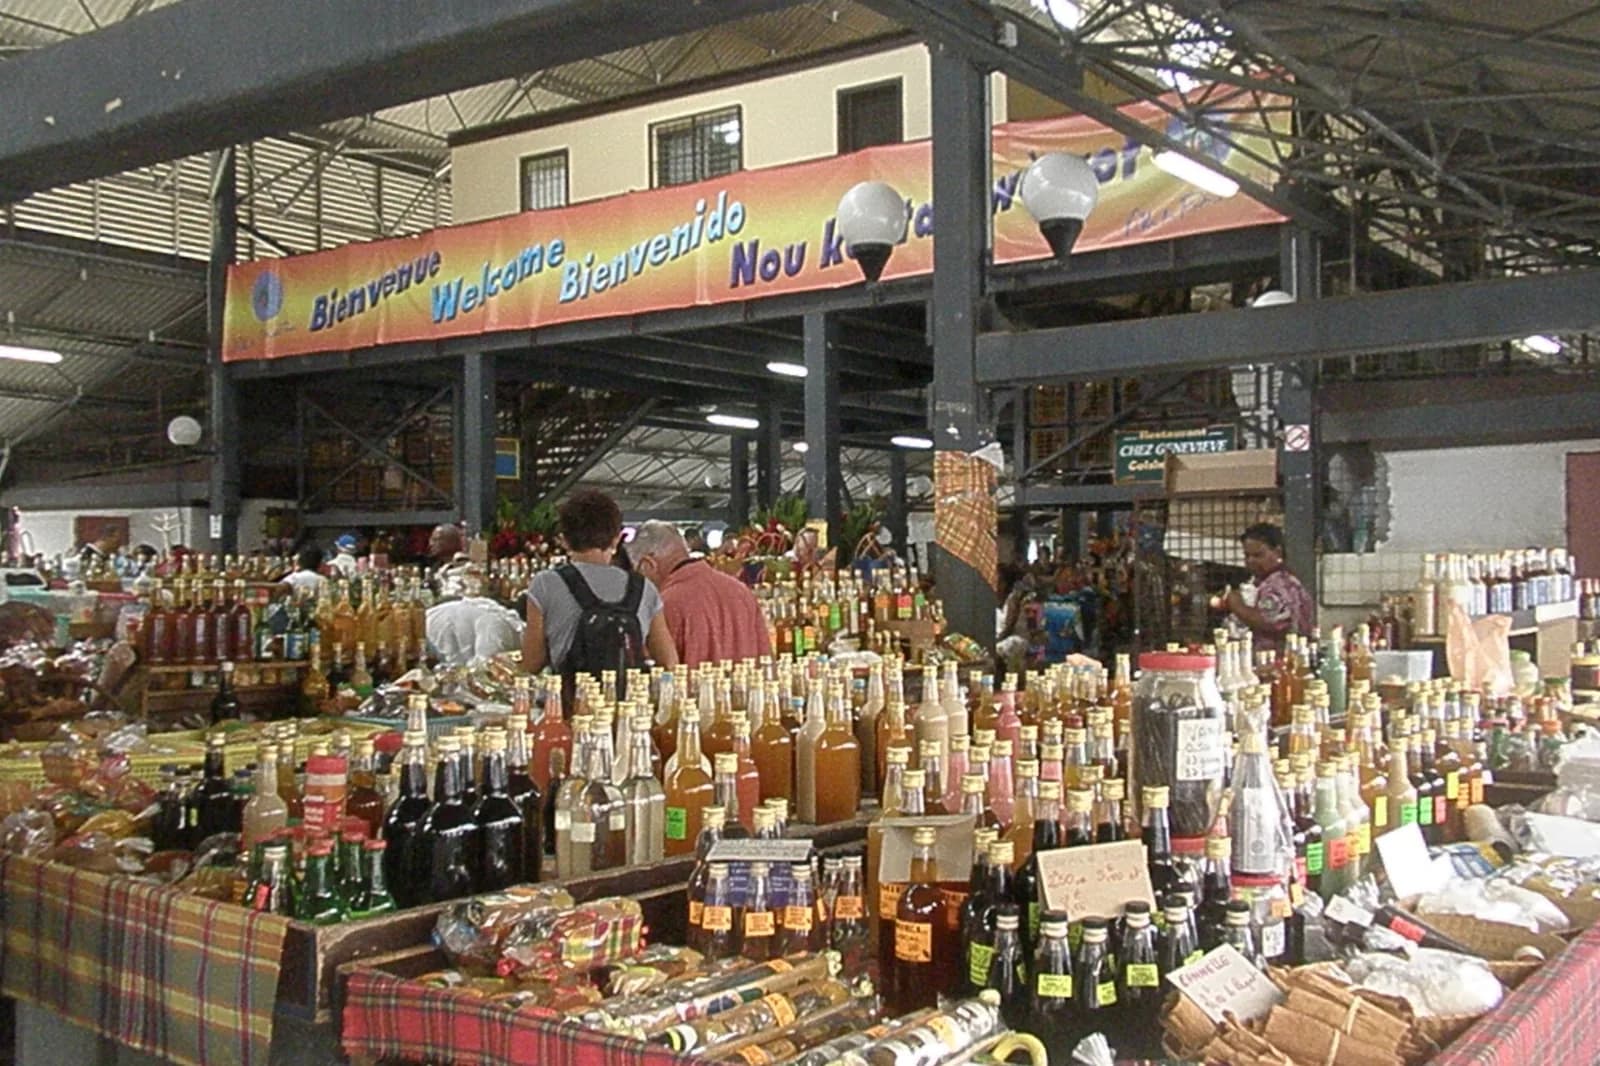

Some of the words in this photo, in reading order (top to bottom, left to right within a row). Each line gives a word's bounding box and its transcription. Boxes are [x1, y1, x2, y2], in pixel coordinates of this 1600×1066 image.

[431, 236, 565, 323] Welcome
[559, 189, 746, 304] Bienvenido
[730, 239, 807, 289] Nou
[309, 250, 442, 331] Bienvenue
[1119, 443, 1154, 457] CHEZ
